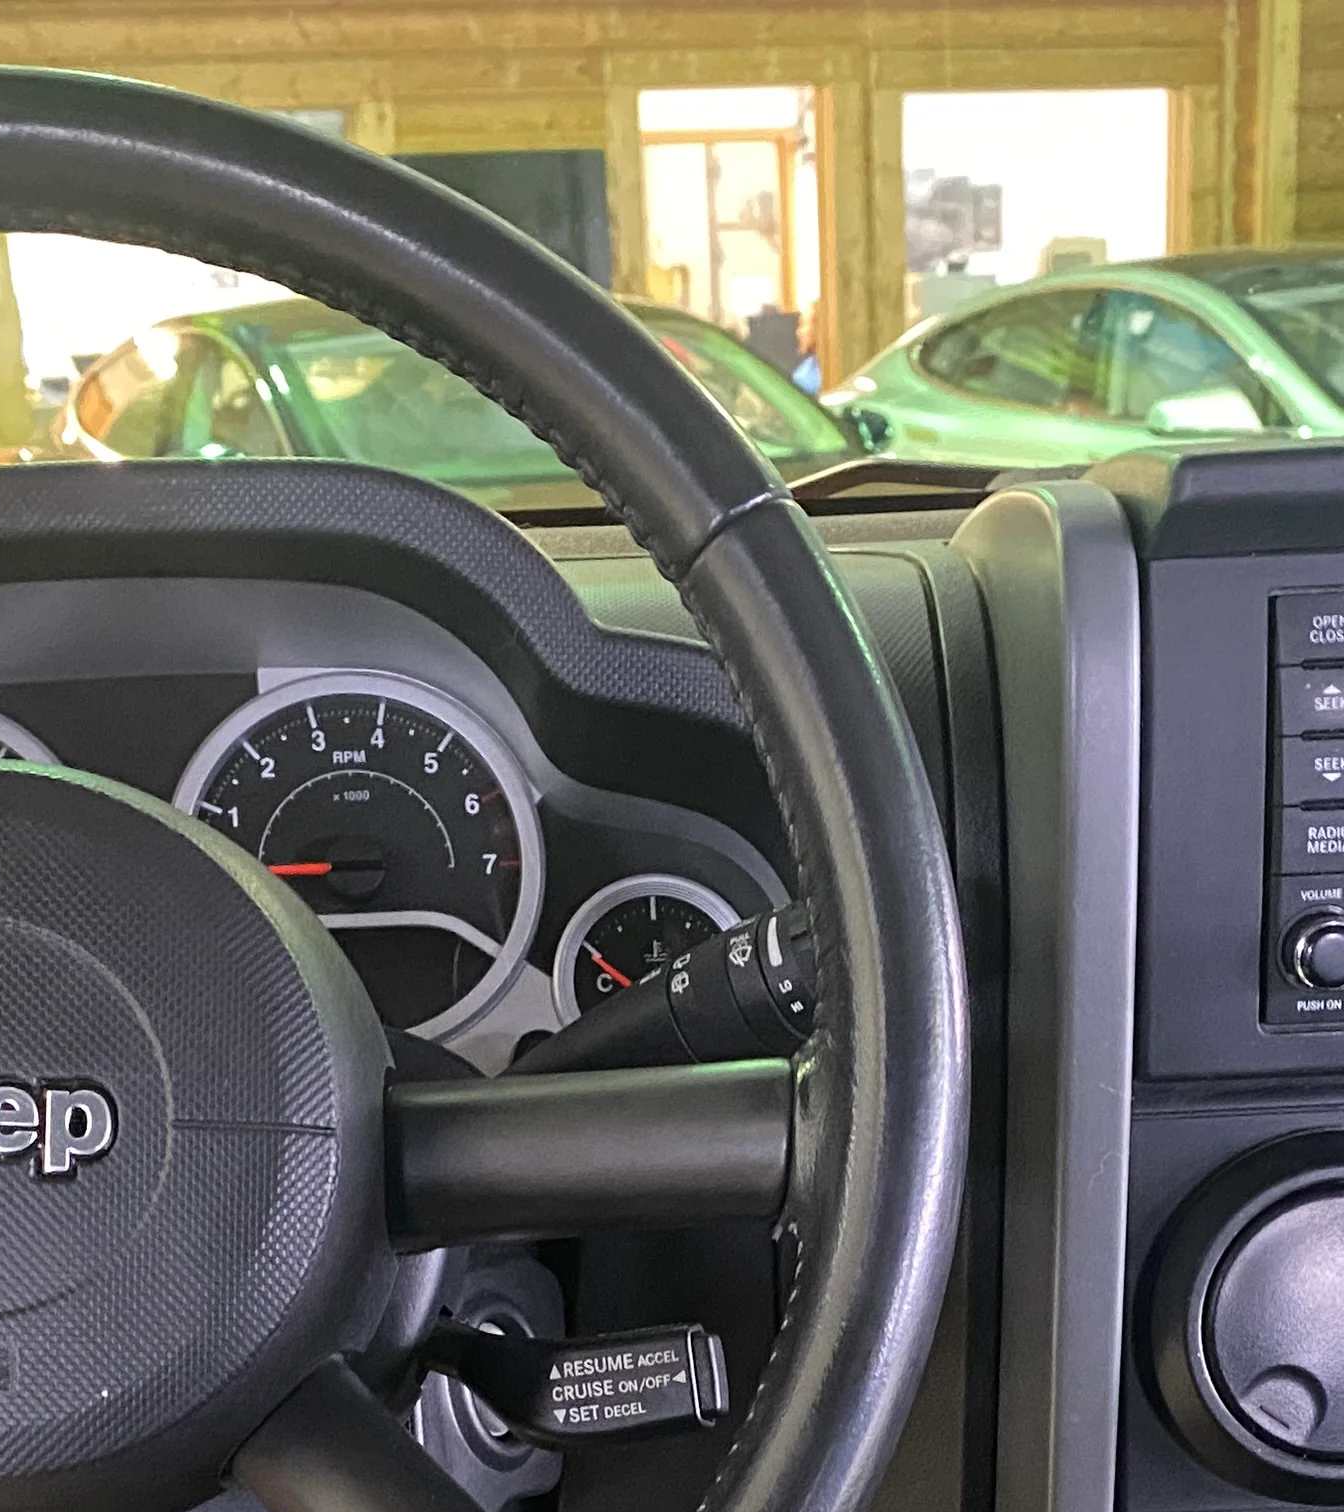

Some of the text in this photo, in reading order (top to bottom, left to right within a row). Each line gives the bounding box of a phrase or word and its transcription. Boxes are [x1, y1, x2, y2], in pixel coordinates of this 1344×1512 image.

[311, 730, 326, 751] 3
[370, 728, 385, 749] 4
[332, 750, 366, 764] RPM
[424, 752, 439, 773] 5
[260, 758, 276, 778] 2
[343, 790, 370, 801] 1000
[464, 794, 480, 815] 6
[227, 807, 239, 828] 1
[482, 853, 497, 875] 7
[1300, 887, 1343, 901] VOLUME
[596, 972, 613, 993] C
[778, 979, 793, 994] LO
[1297, 998, 1342, 1012] PUSH ON
[563, 1349, 679, 1378] RESUME ACCEL
[552, 1374, 671, 1402] CRUISE ON/OFF
[569, 1401, 646, 1424] SET DECEL
